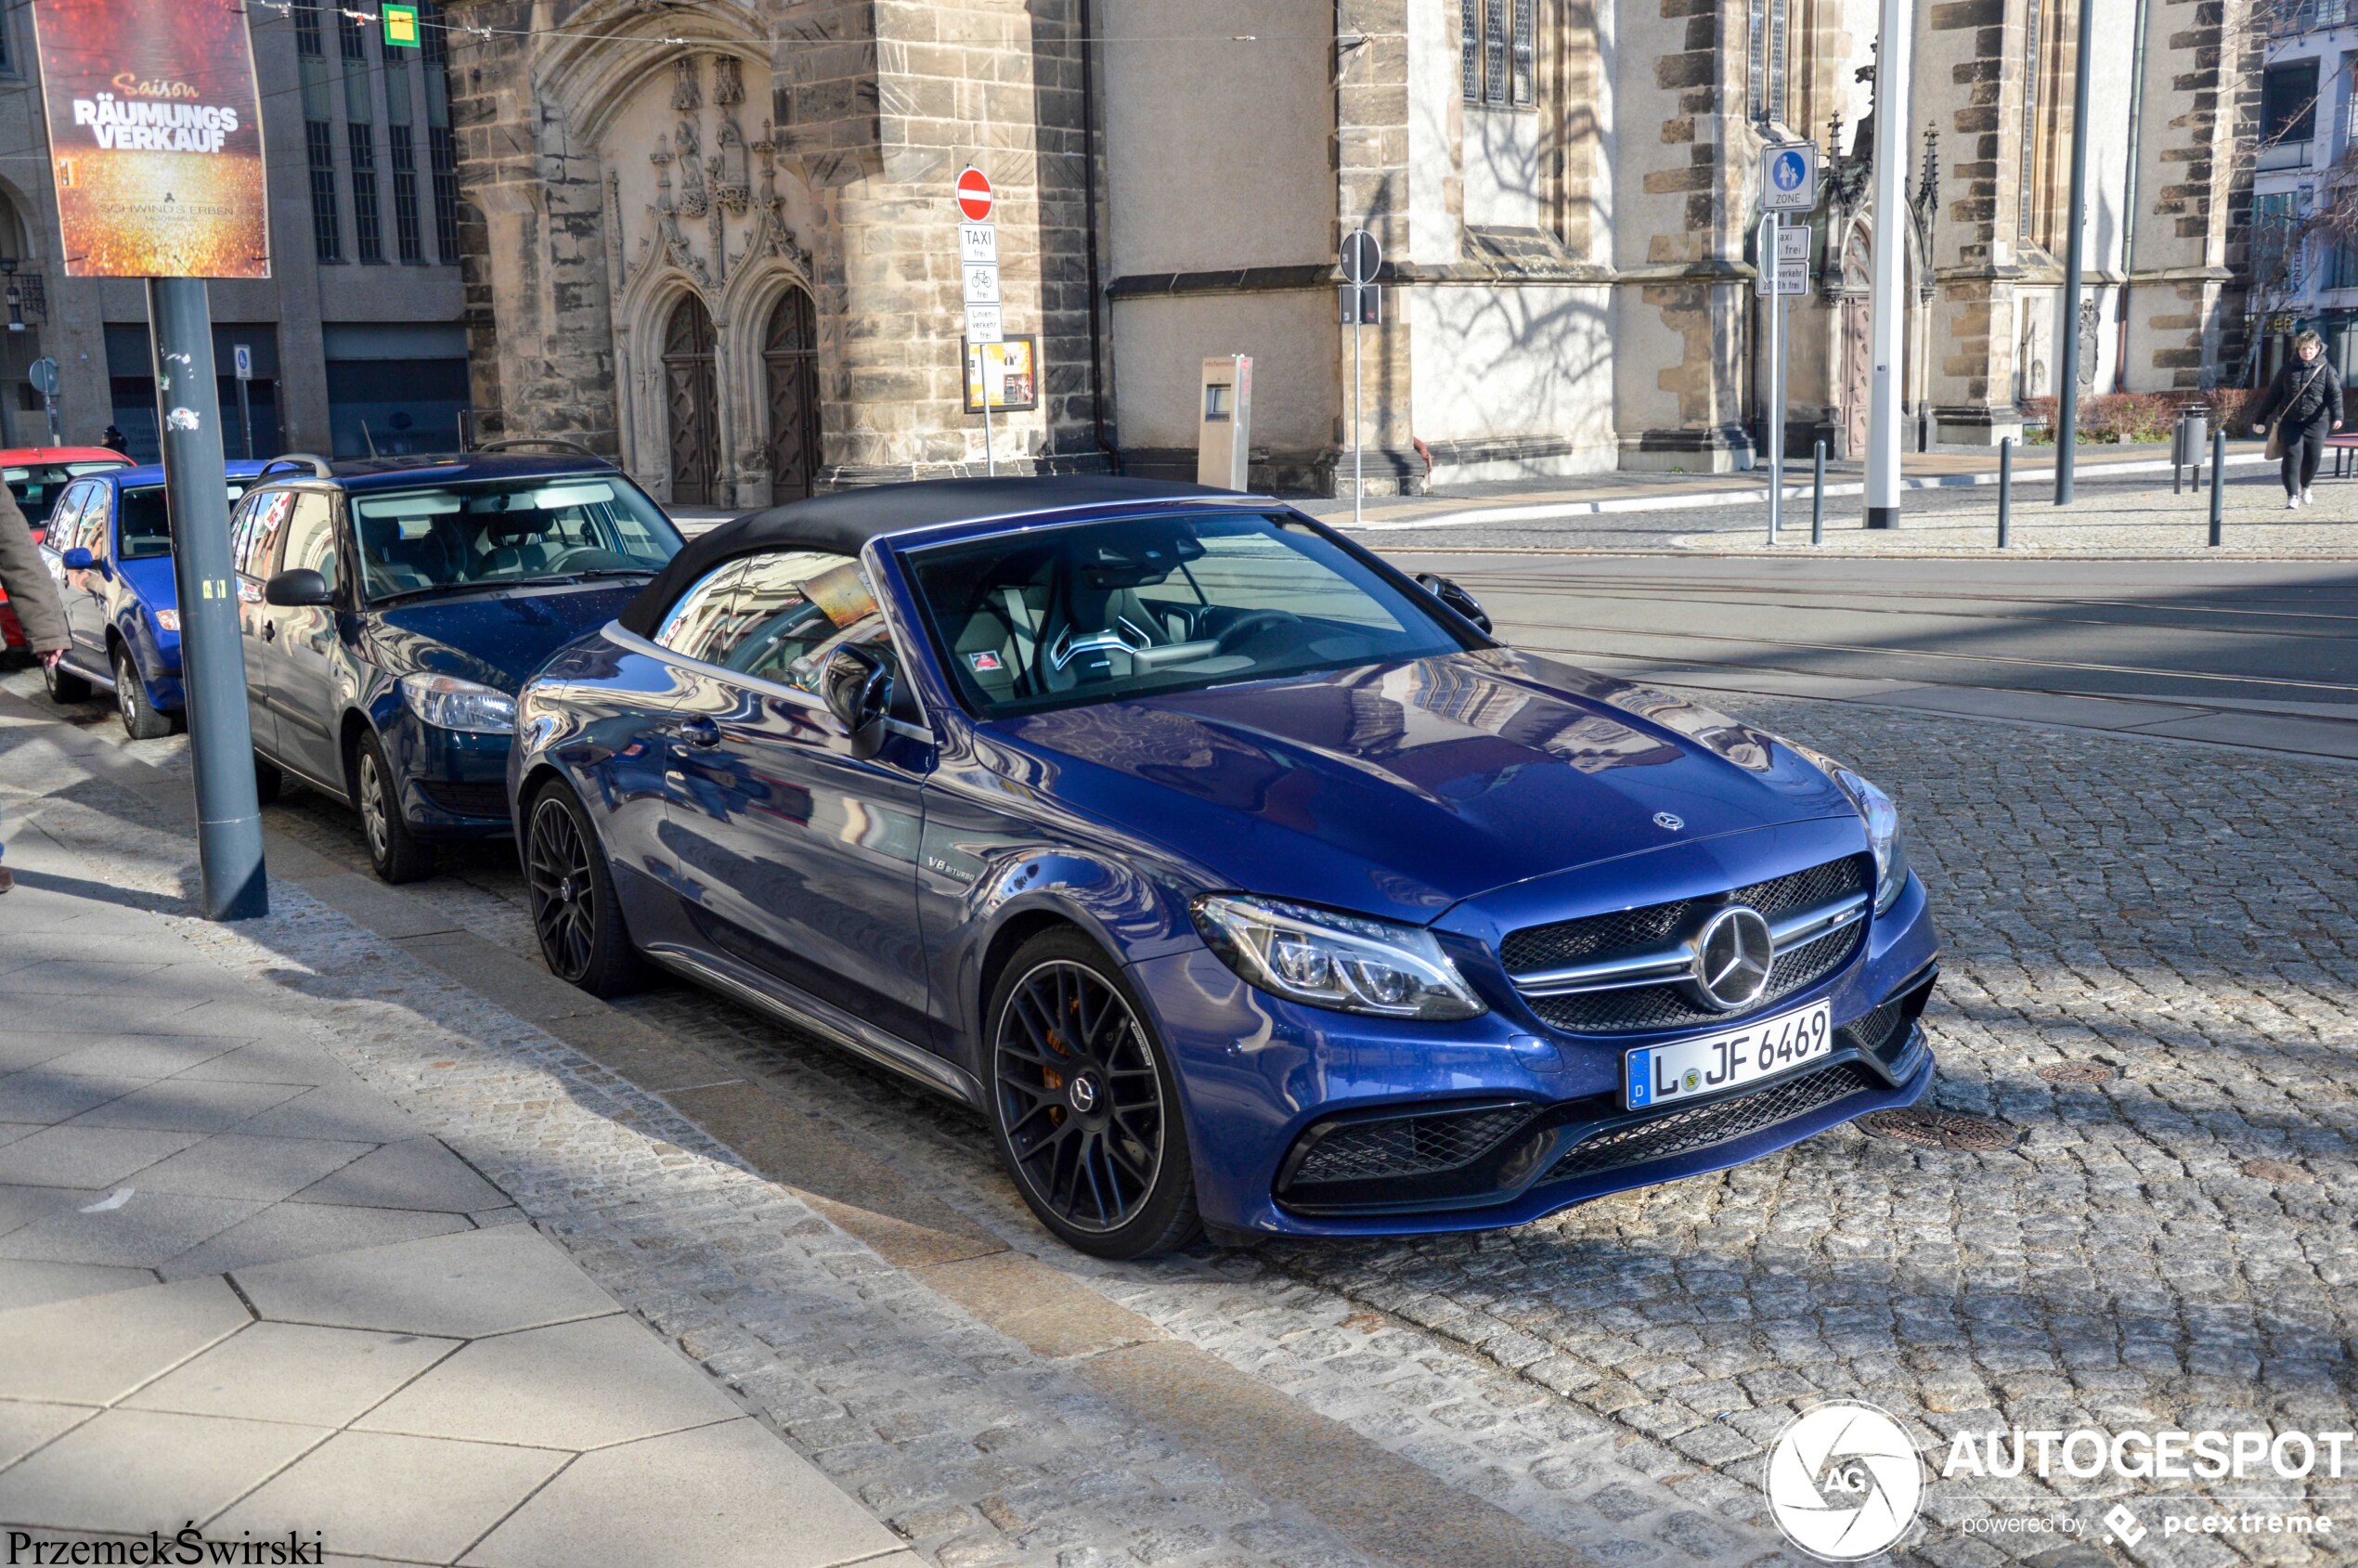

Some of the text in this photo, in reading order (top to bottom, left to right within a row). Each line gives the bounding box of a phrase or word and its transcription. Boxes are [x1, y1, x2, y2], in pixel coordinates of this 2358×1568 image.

[112, 73, 201, 98] Saison
[73, 93, 239, 132] RÄUMUNGS
[93, 124, 226, 153] VERKAUF
[1776, 193, 1801, 204] ZONE
[189, 205, 234, 215] ERBEN
[965, 230, 991, 245] TAXI
[1780, 232, 1793, 241] axi
[974, 249, 986, 257] frei
[1785, 244, 1802, 254] frei
[1788, 280, 1800, 290] frei
[977, 290, 989, 299] frei
[972, 310, 995, 318] Linien-
[972, 320, 997, 329] verkehr
[979, 331, 991, 340] frei
[928, 856, 976, 881] V8 BITURBO
[1655, 1010, 1827, 1097] L JF 6469
[1634, 1084, 1644, 1098] D
